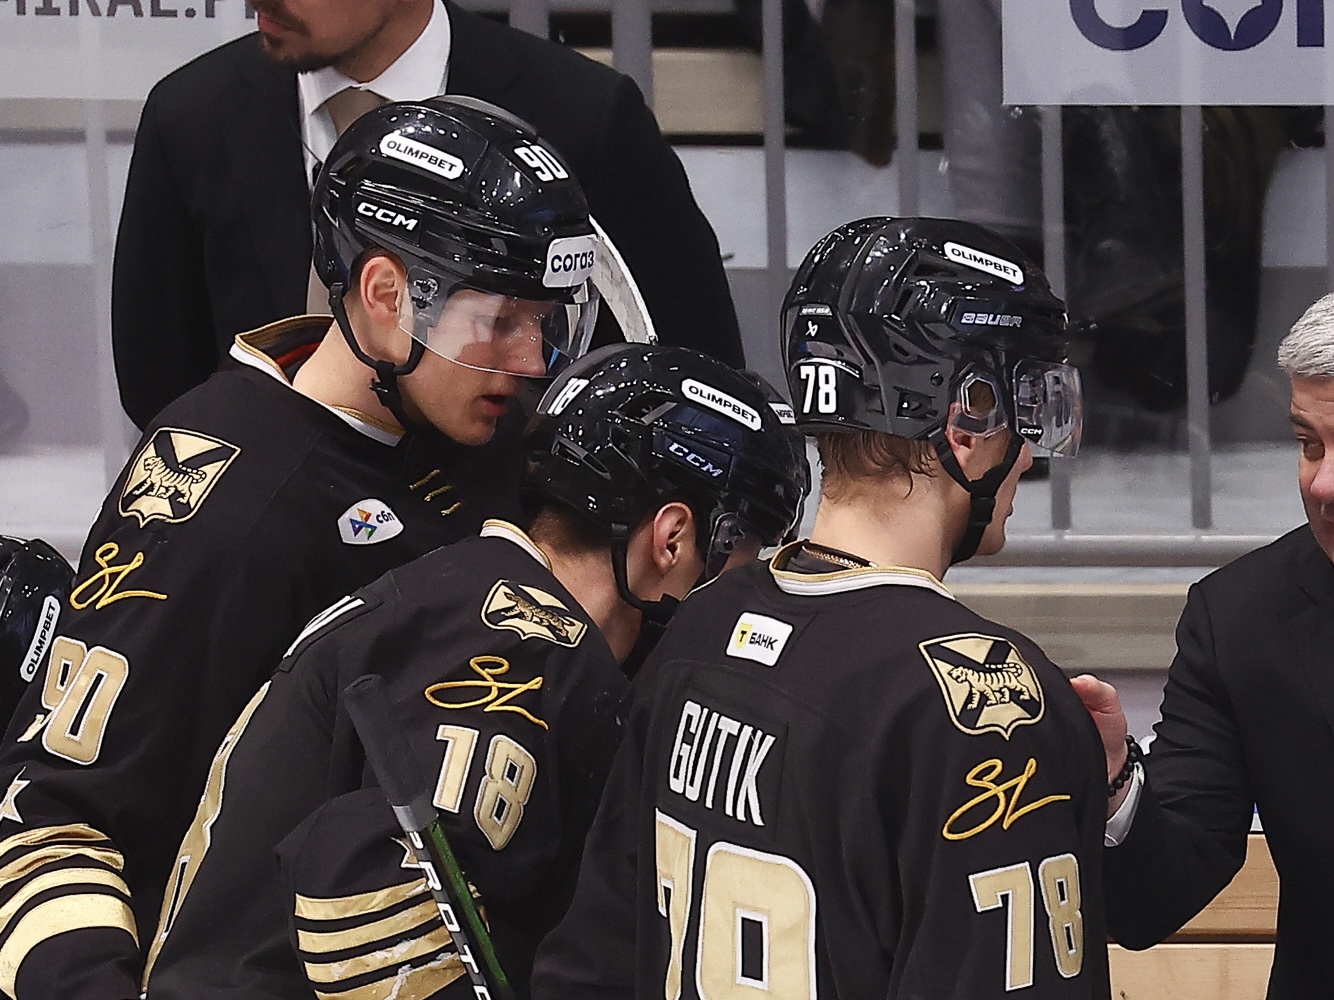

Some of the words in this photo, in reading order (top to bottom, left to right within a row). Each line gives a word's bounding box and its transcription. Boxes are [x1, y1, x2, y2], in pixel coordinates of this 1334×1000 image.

[387, 140, 458, 173] OLIMPBET
[514, 144, 569, 182] 90
[357, 201, 419, 231] CCM
[951, 247, 1020, 279] OLIMPBET
[547, 377, 591, 416] 18
[688, 385, 758, 424] OLIMPBET
[800, 364, 837, 414] 78
[1020, 427, 1043, 436] CCM
[668, 441, 725, 478] CCM
[26, 601, 56, 676] OLIMPBET
[748, 632, 779, 651] БАНК
[17, 635, 129, 766] 90
[667, 699, 776, 827] GUTIK
[431, 723, 538, 852] 18
[967, 852, 1085, 993] 78
